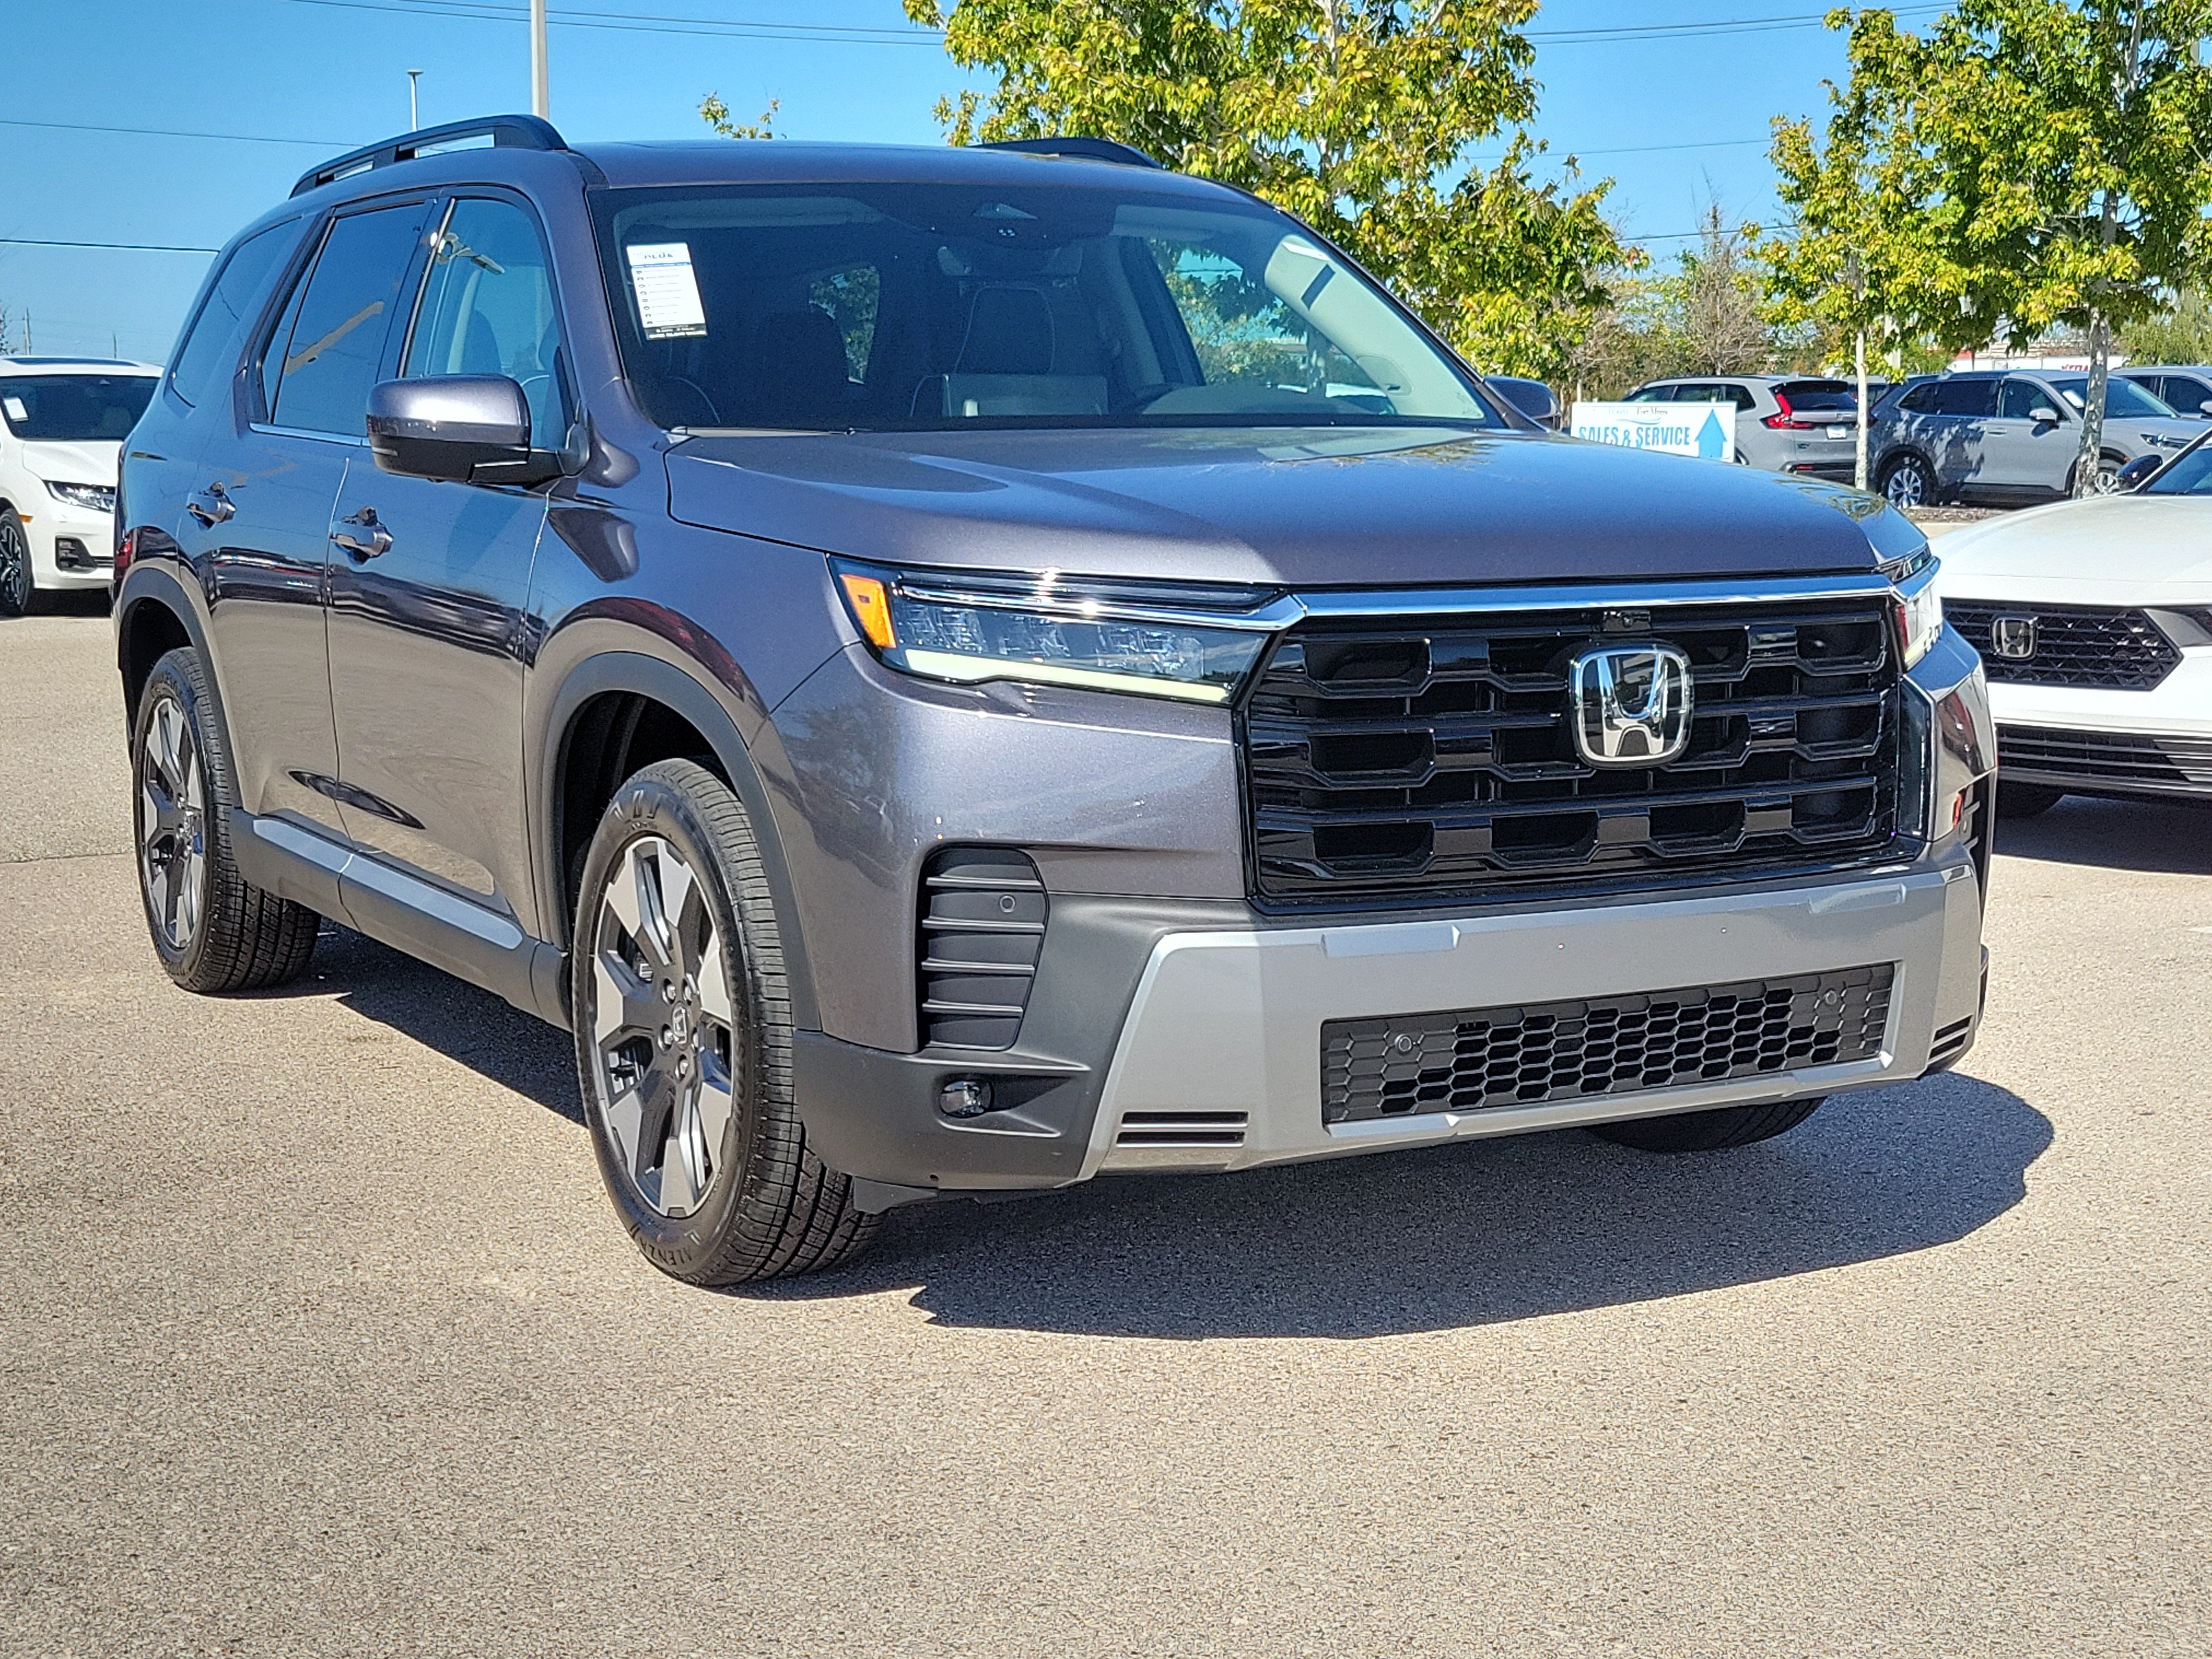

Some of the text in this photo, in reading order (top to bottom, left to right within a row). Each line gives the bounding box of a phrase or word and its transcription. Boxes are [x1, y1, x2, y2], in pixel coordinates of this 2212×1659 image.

[1578, 426, 1690, 449] SALES & SERVICE
